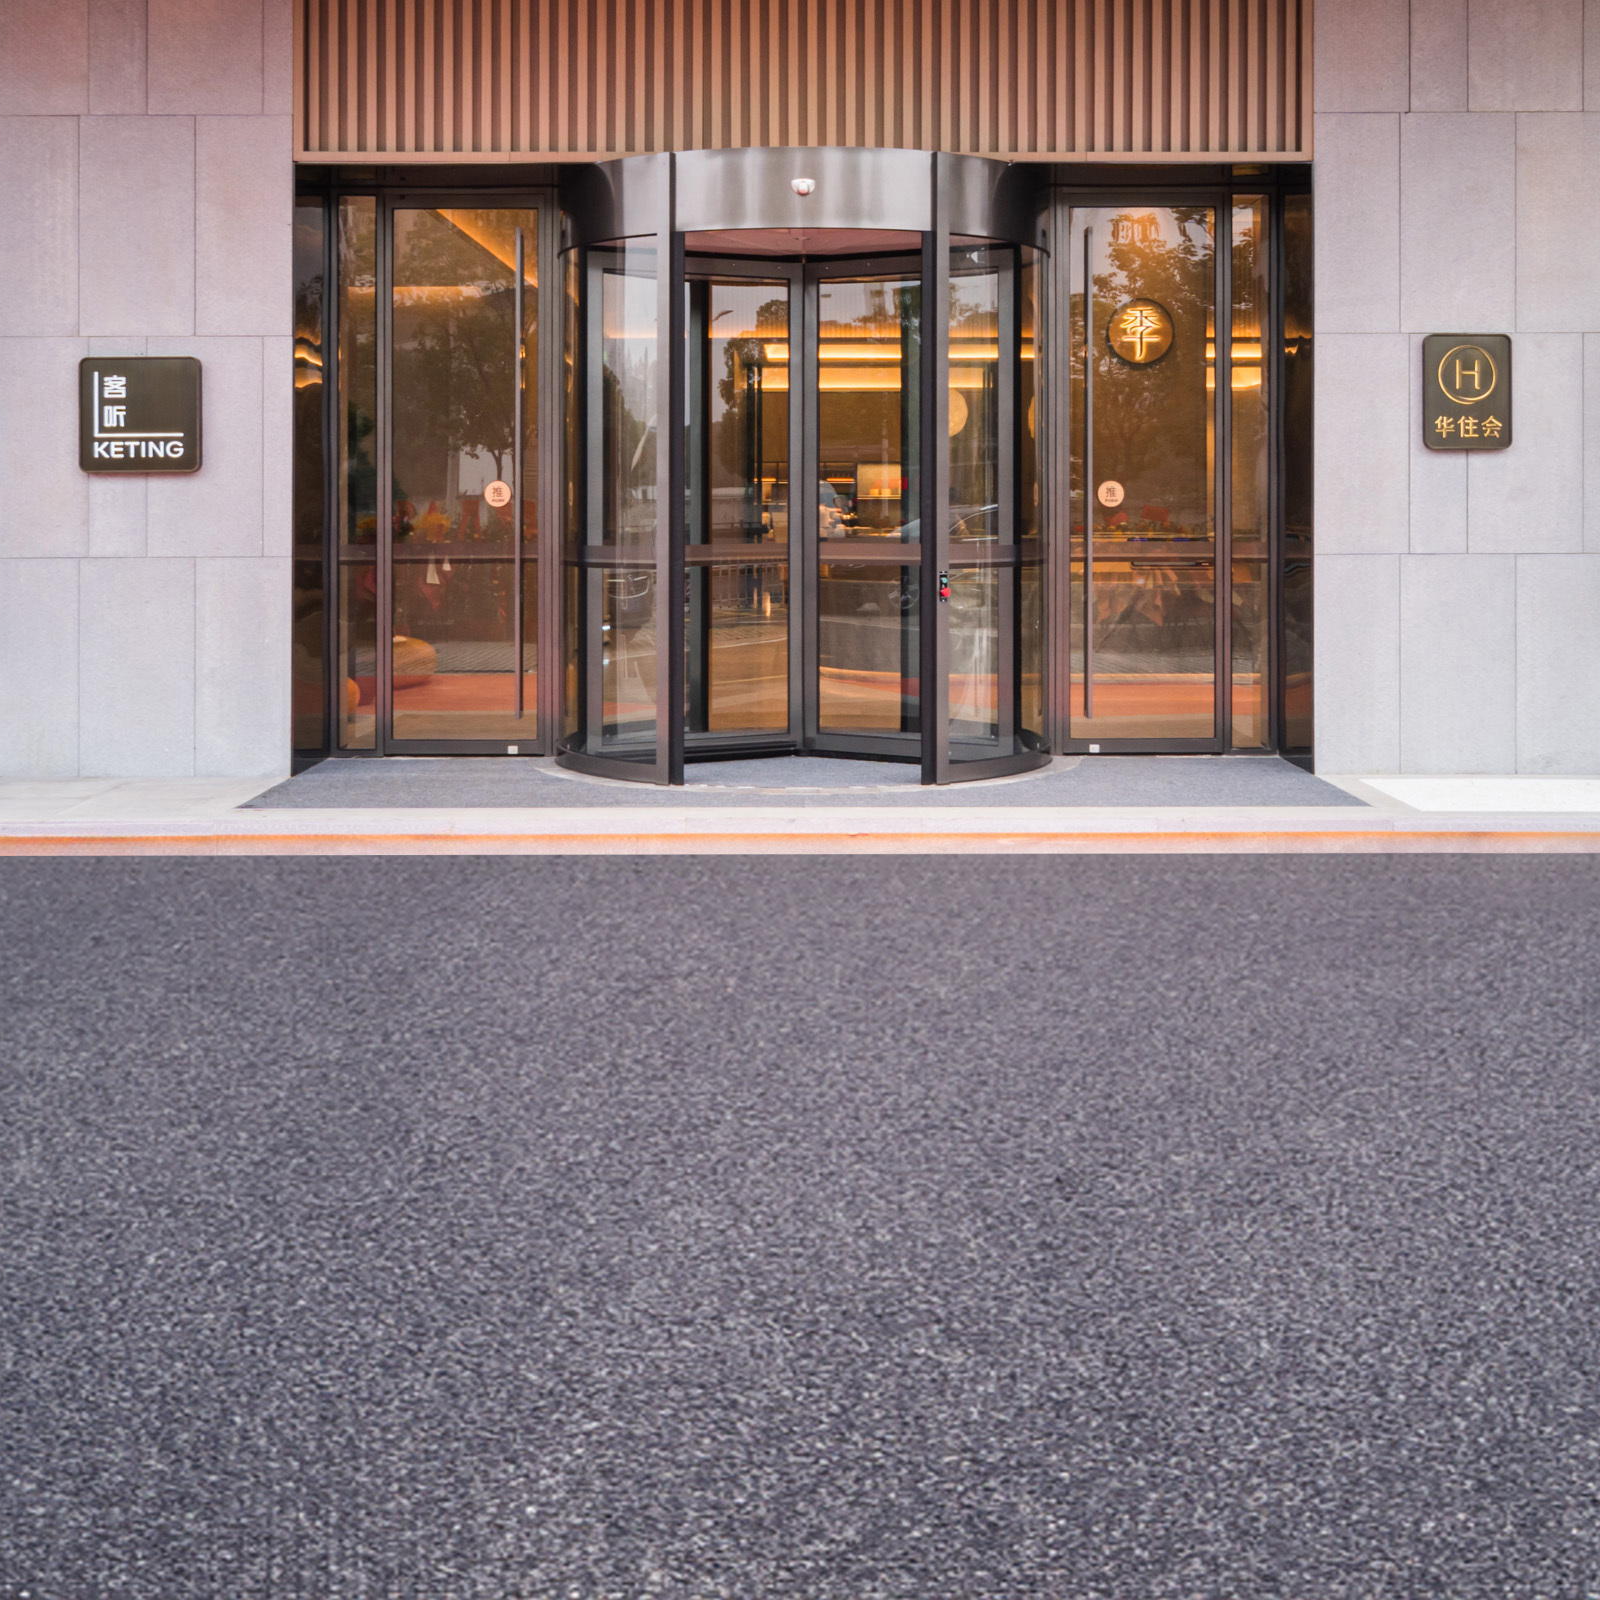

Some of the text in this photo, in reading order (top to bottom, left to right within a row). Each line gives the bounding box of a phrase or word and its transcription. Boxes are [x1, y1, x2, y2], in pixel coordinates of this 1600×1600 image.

[1120, 307, 1161, 360] 季
[103, 374, 127, 428] 客听
[1434, 415, 1503, 438] 华住会
[93, 441, 185, 459] KETING
[492, 486, 503, 498] 推
[1105, 486, 1117, 498] 推
